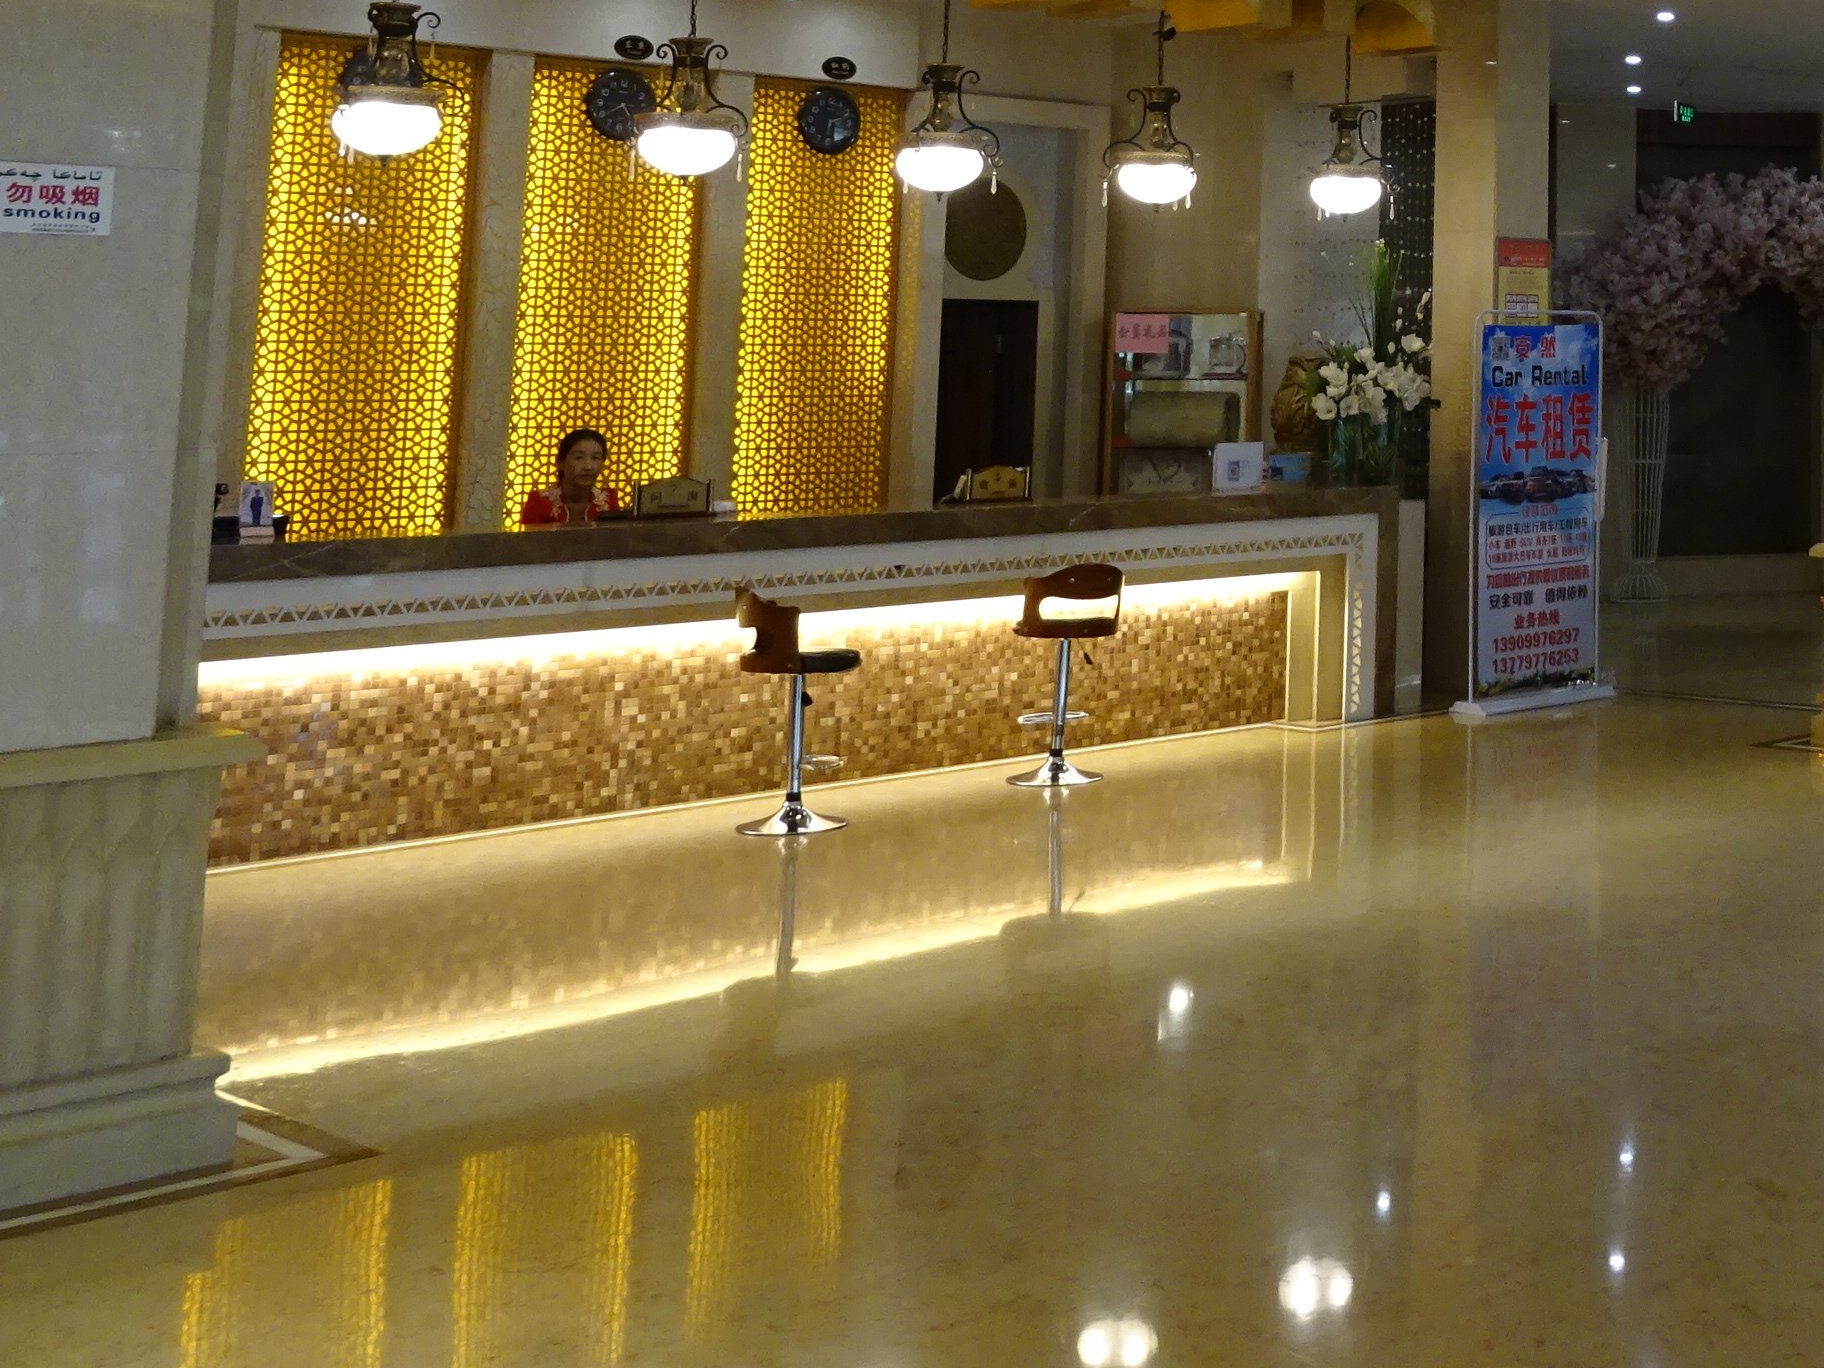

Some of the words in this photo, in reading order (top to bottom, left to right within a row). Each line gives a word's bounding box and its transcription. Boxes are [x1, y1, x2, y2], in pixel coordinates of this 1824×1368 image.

[6, 182, 101, 207] 勿吸烟
[3, 207, 101, 224] smoking
[1492, 365, 1522, 387] Car
[1531, 364, 1588, 386] Rental
[1485, 392, 1594, 465] 汽车租赁
[1489, 590, 1534, 610] 安全可靠
[1513, 608, 1560, 630] 业务热线
[1493, 627, 1580, 653] 13909976297
